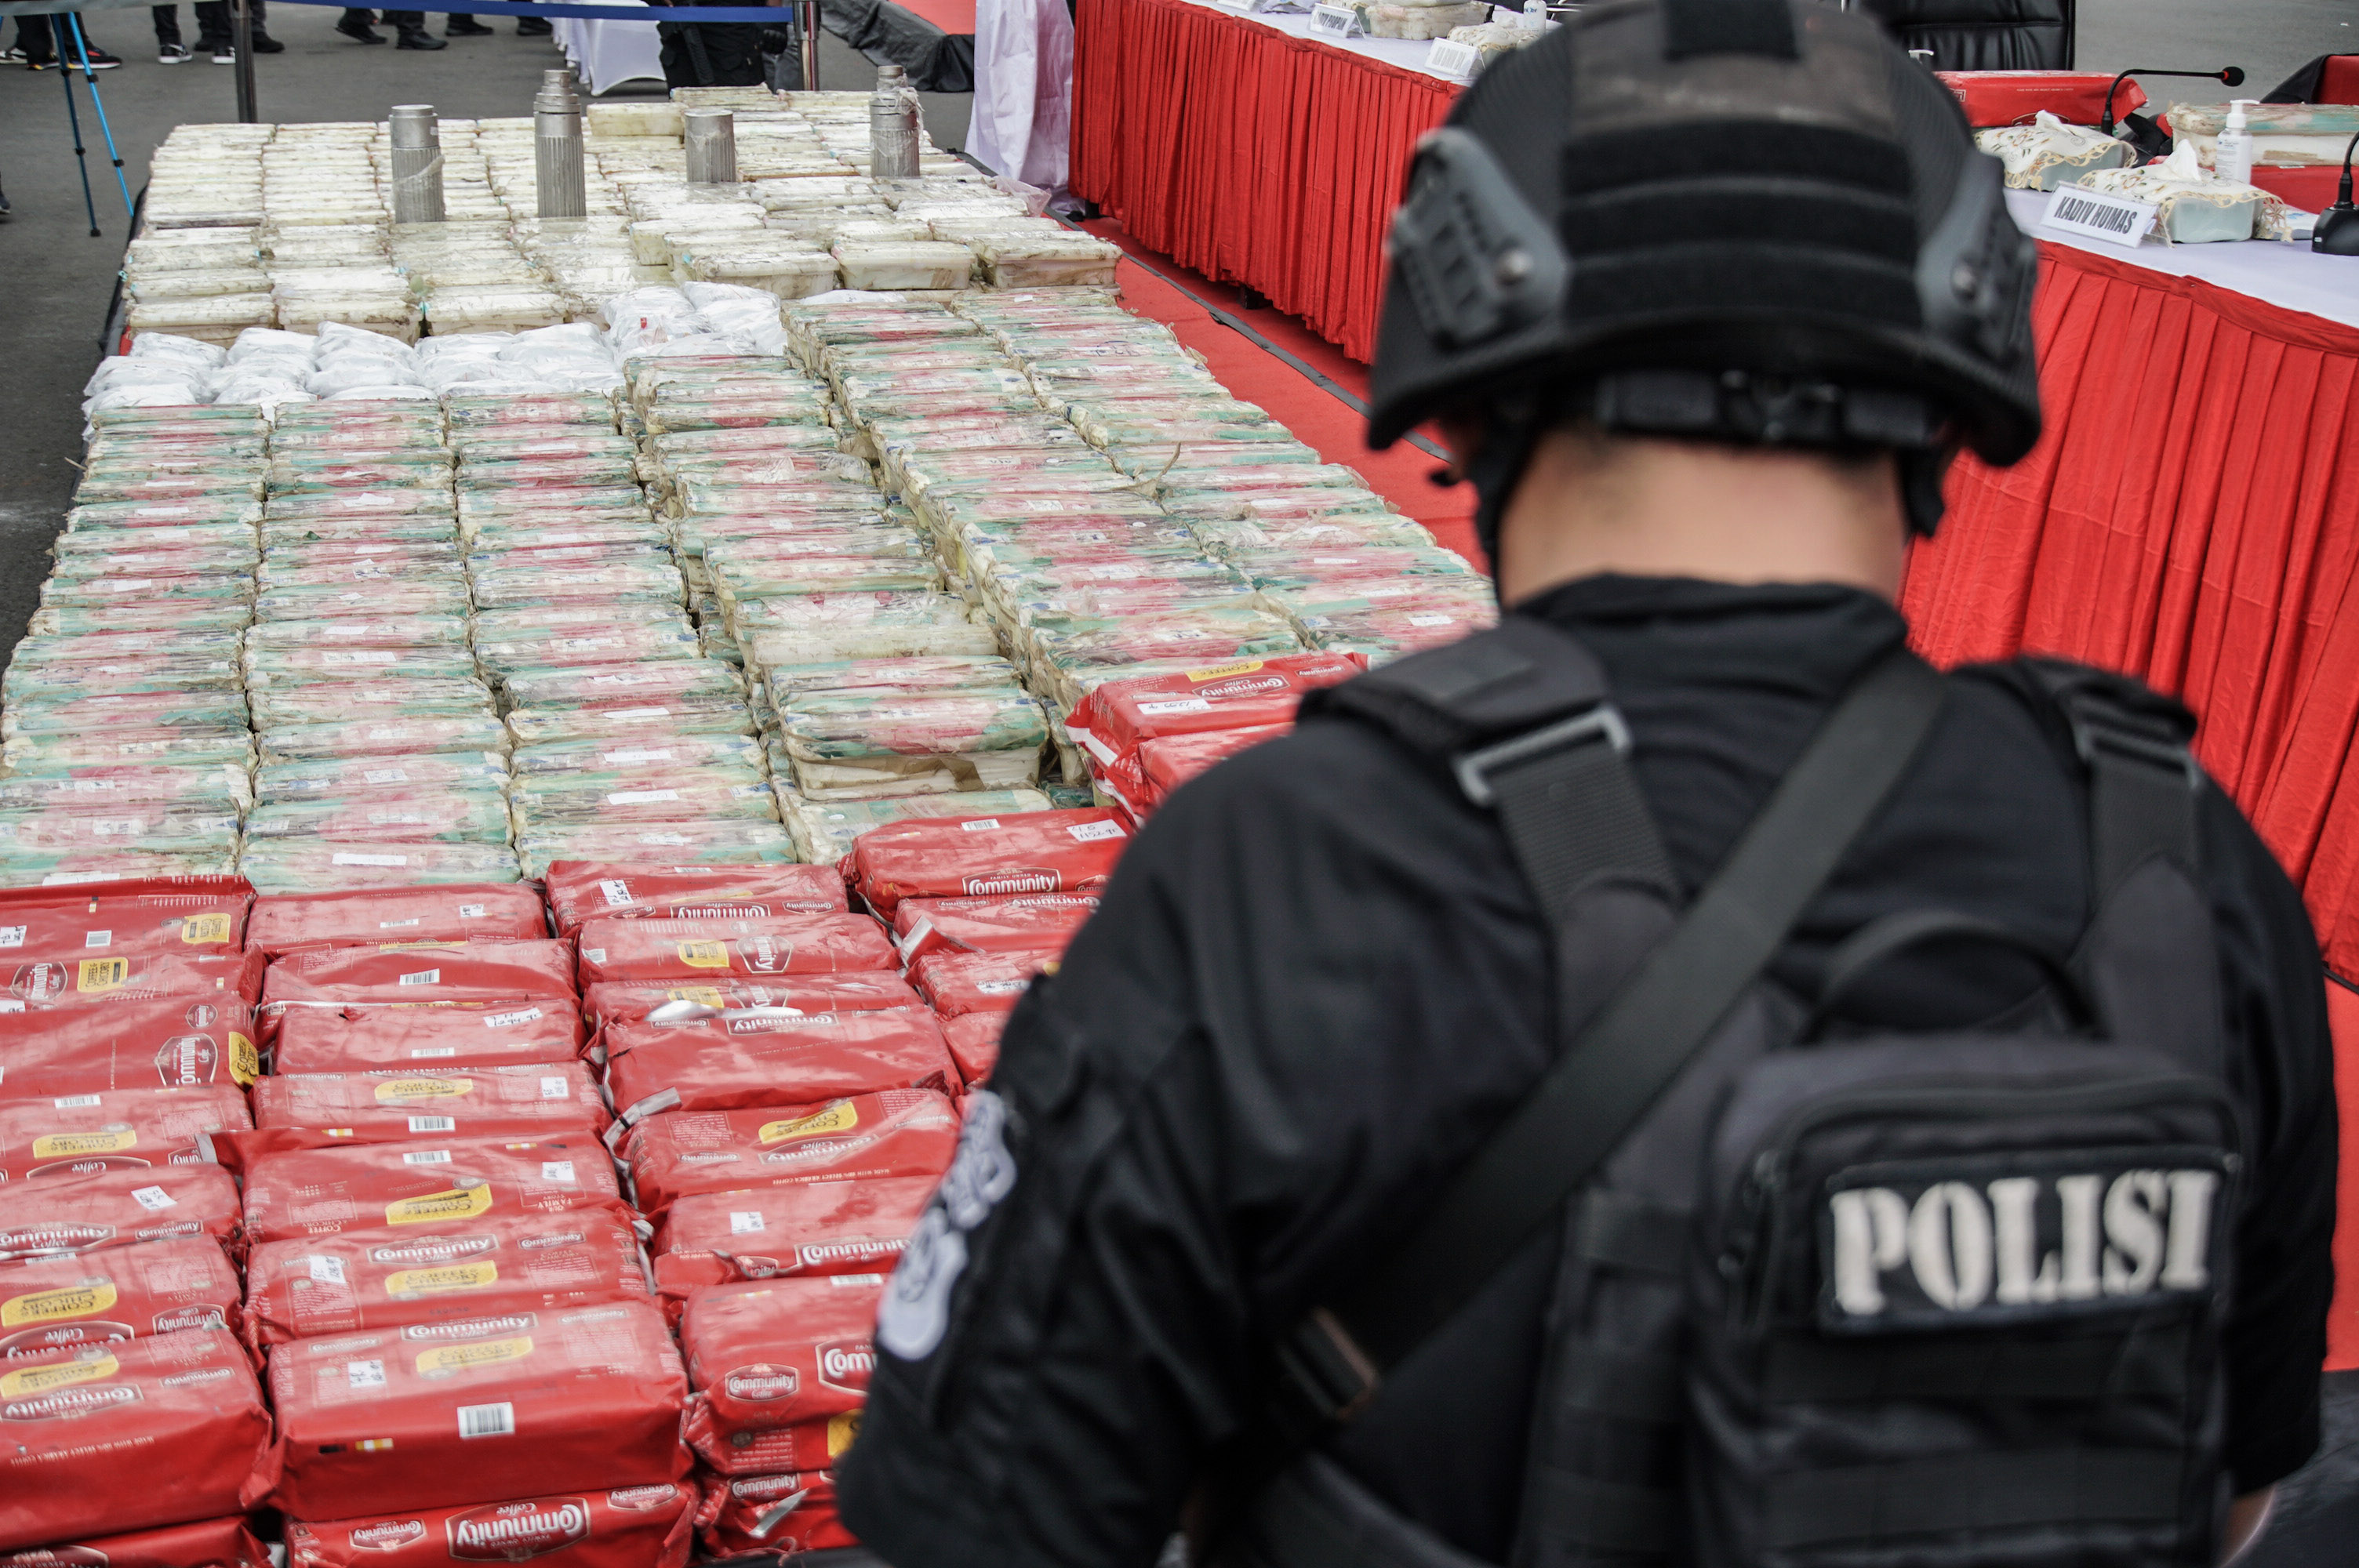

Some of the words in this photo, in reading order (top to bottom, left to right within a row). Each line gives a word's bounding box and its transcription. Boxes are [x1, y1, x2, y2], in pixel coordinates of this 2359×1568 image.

[2054, 195, 2097, 225] KADIV
[2090, 205, 2138, 235] HUMAS
[1299, 666, 1343, 676] Community
[1201, 677, 1284, 698] Community
[1225, 680, 1250, 689] Coffee
[969, 874, 1055, 895] Community
[678, 906, 764, 919] Community
[787, 901, 831, 910] Community
[1011, 897, 1100, 912] Community
[654, 1019, 707, 1028] Community
[735, 1015, 832, 1033] Community
[198, 1048, 209, 1063] Coffee
[767, 1135, 872, 1162] Community
[801, 1141, 833, 1150] Coffee
[681, 1152, 738, 1162] Community
[71, 1158, 107, 1174] Coffee
[772, 1177, 794, 1185] COFFEE
[538, 1199, 572, 1209] FAMILY
[137, 1221, 199, 1238] Community
[307, 1225, 342, 1234] COFFEE
[31, 1238, 68, 1249] Coffee
[521, 1232, 581, 1248] Community
[1830, 1168, 2221, 1316] POLISI
[373, 1237, 491, 1263] Community
[801, 1238, 911, 1265] Communit
[416, 1254, 453, 1264] Coffee
[31, 1301, 94, 1317] COFFEE
[157, 1309, 224, 1332] Community
[407, 1316, 529, 1338] Community
[44, 1327, 85, 1345] Coffee
[163, 1368, 231, 1387] Community
[729, 1374, 794, 1393] Community
[5, 1387, 135, 1417] Community
[611, 1483, 675, 1501] Community
[732, 1473, 797, 1497] Community
[496, 1501, 537, 1517] Coffee
[354, 1520, 422, 1541] Community
[457, 1504, 583, 1547] Community
